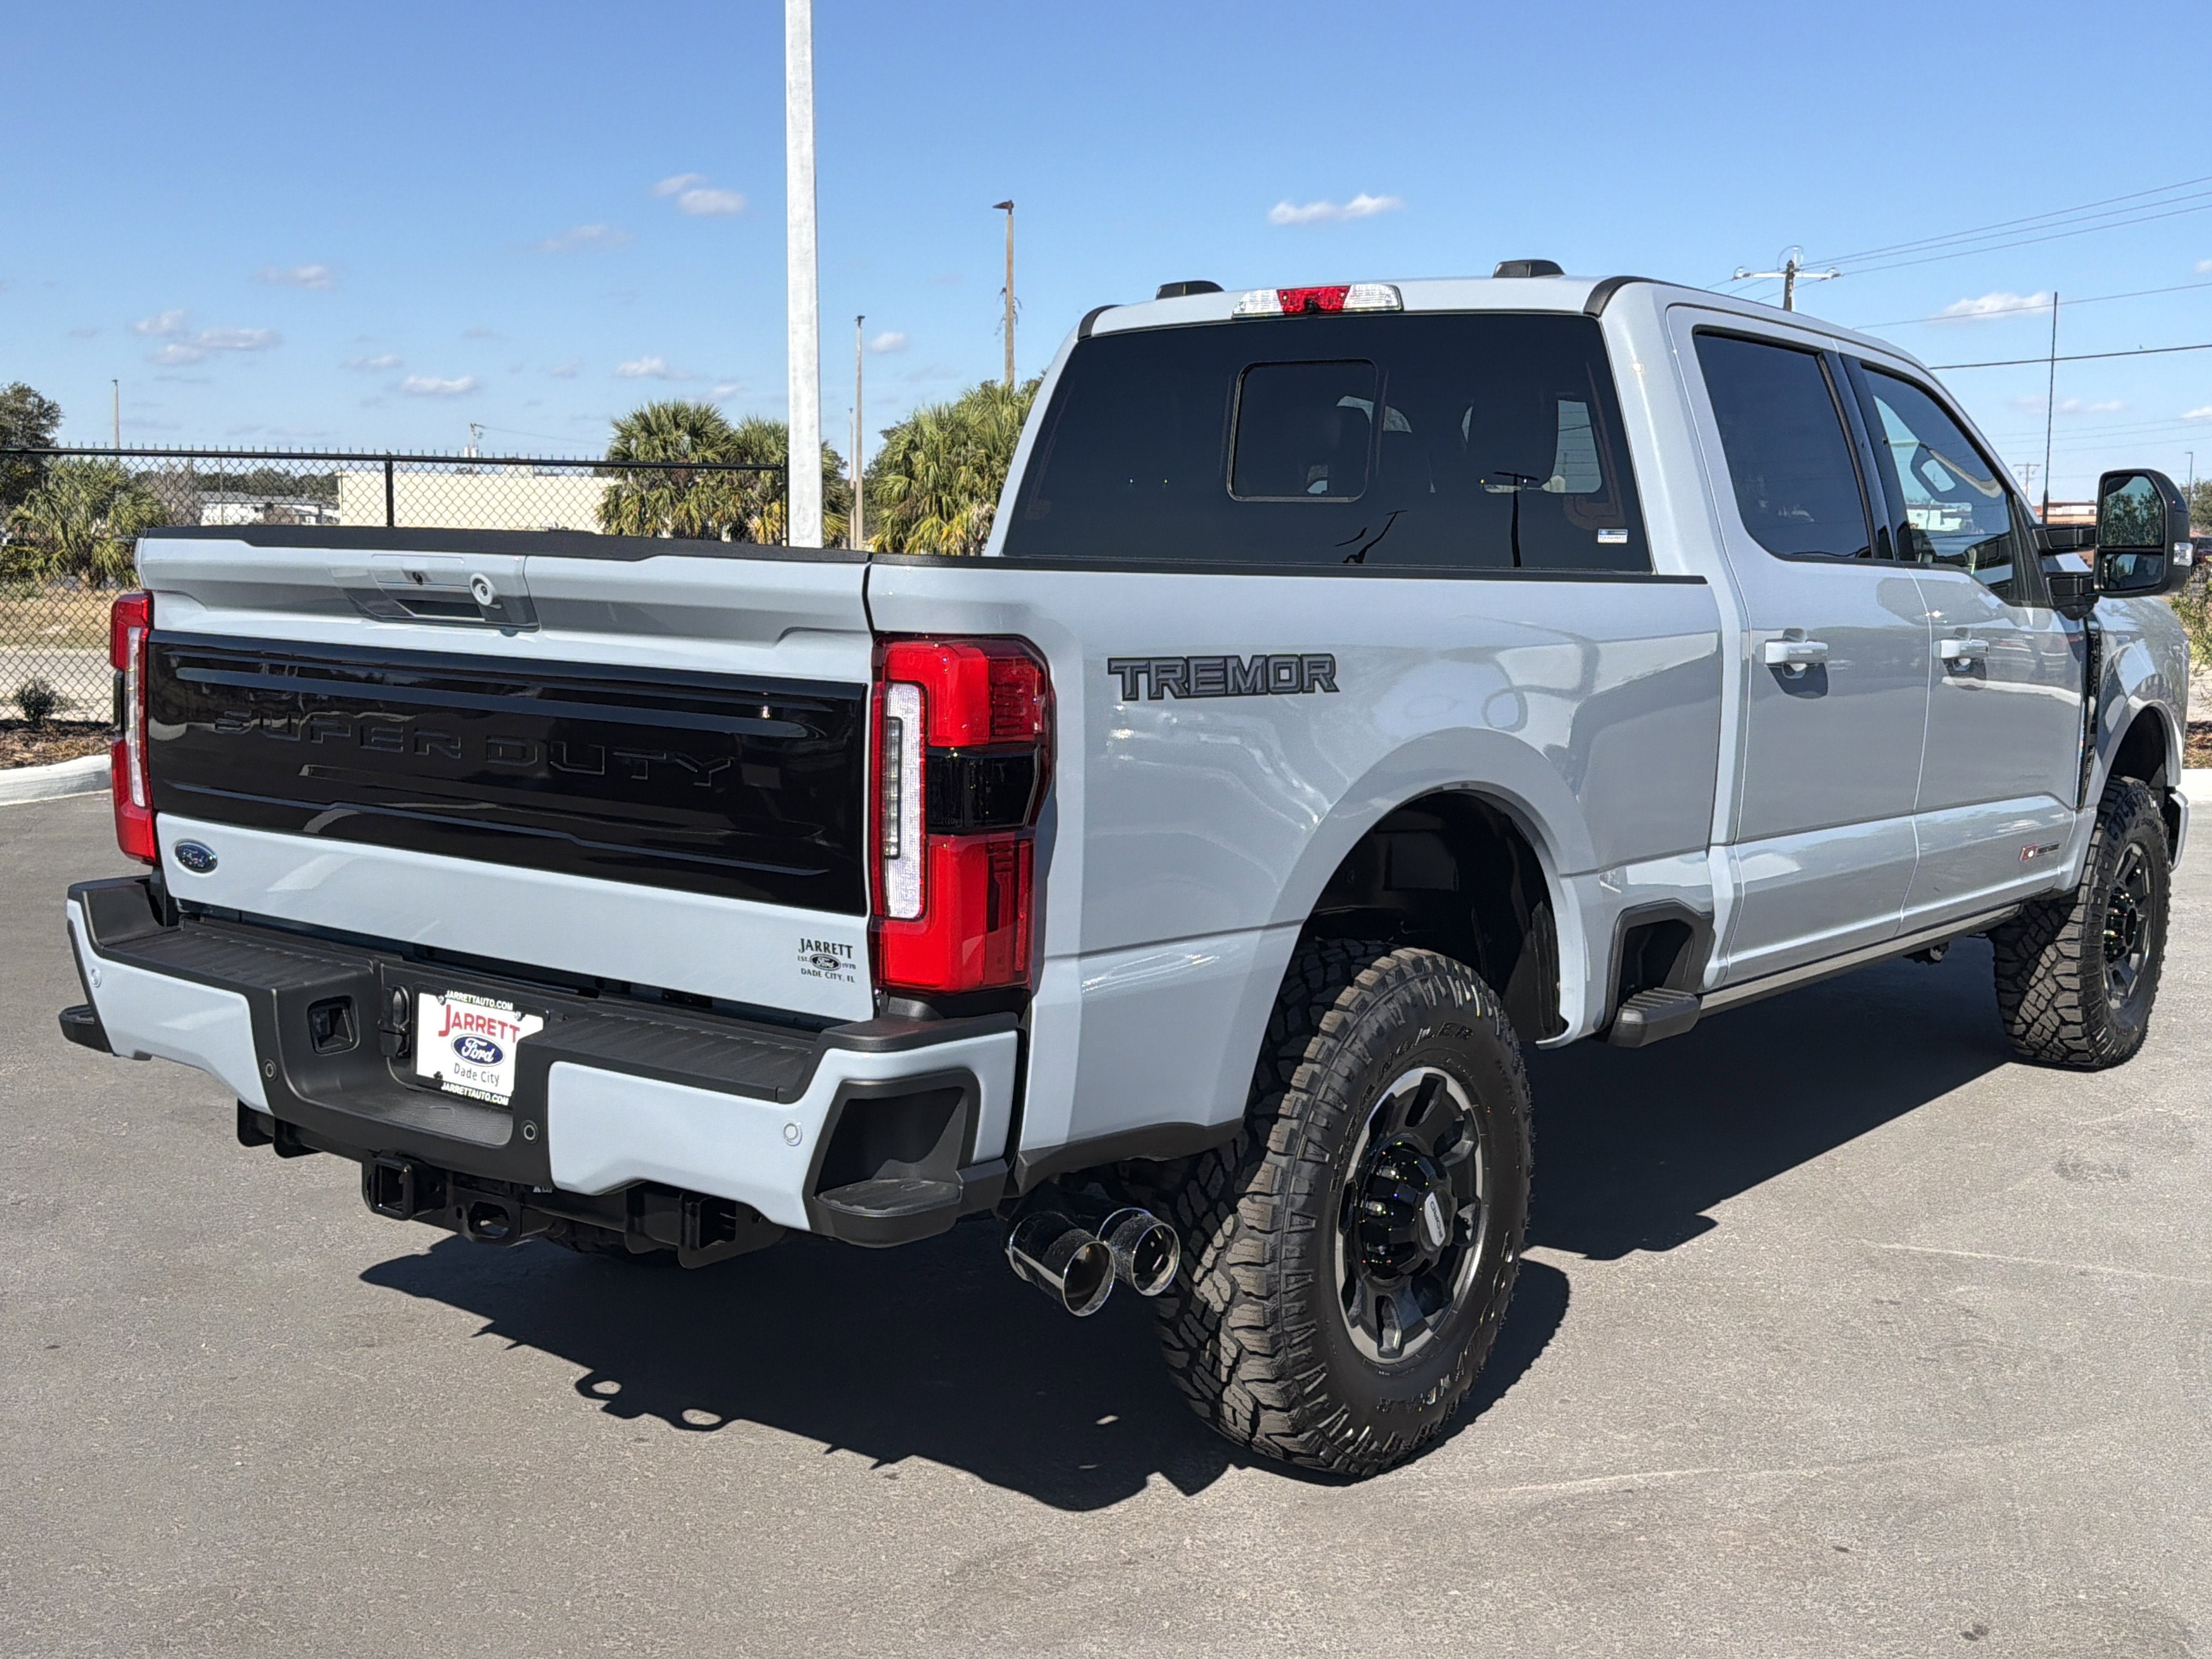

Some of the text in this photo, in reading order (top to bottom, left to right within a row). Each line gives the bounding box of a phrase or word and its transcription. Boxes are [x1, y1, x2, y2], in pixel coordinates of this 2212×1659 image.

[1107, 653, 1340, 701] TREMOR
[214, 709, 733, 787] SUPER DUTY
[798, 938, 853, 959] JARRETT
[801, 967, 822, 978] DADE
[445, 990, 514, 1011] JARRETTAUTO.COM
[438, 1004, 520, 1043] JARRETT
[461, 1036, 495, 1063] Ford
[454, 1063, 500, 1087] Dade City
[441, 1082, 510, 1107] JARRETTAUTO.COM
